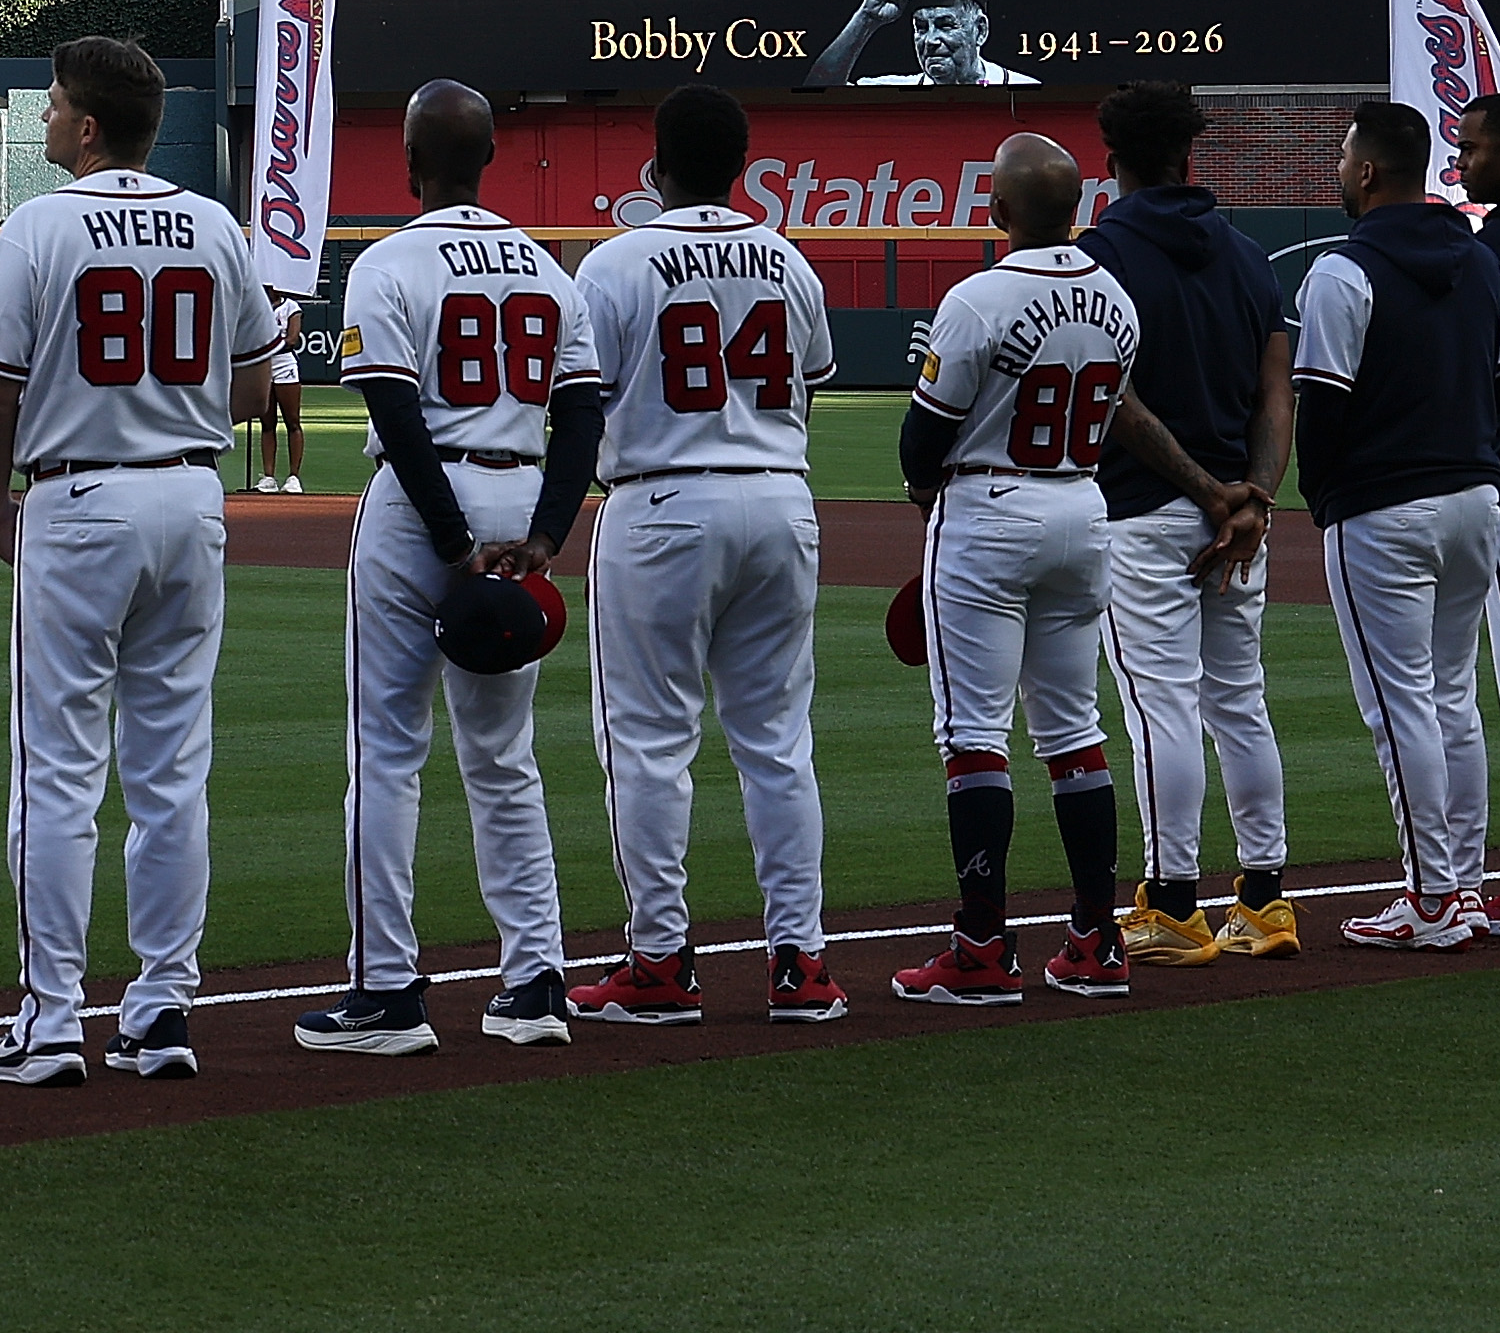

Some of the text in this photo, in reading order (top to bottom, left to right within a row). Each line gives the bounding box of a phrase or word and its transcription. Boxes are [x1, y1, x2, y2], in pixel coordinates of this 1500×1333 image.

[590, 17, 716, 73] Bobby
[725, 18, 808, 60] Cox
[743, 157, 944, 229] State
[81, 209, 195, 250] HYERS
[438, 240, 539, 277] COLES
[650, 242, 786, 287] WATKINS
[73, 265, 215, 387] 80
[437, 291, 561, 408] 88
[657, 298, 794, 414] 84
[1006, 361, 1124, 469] 86
